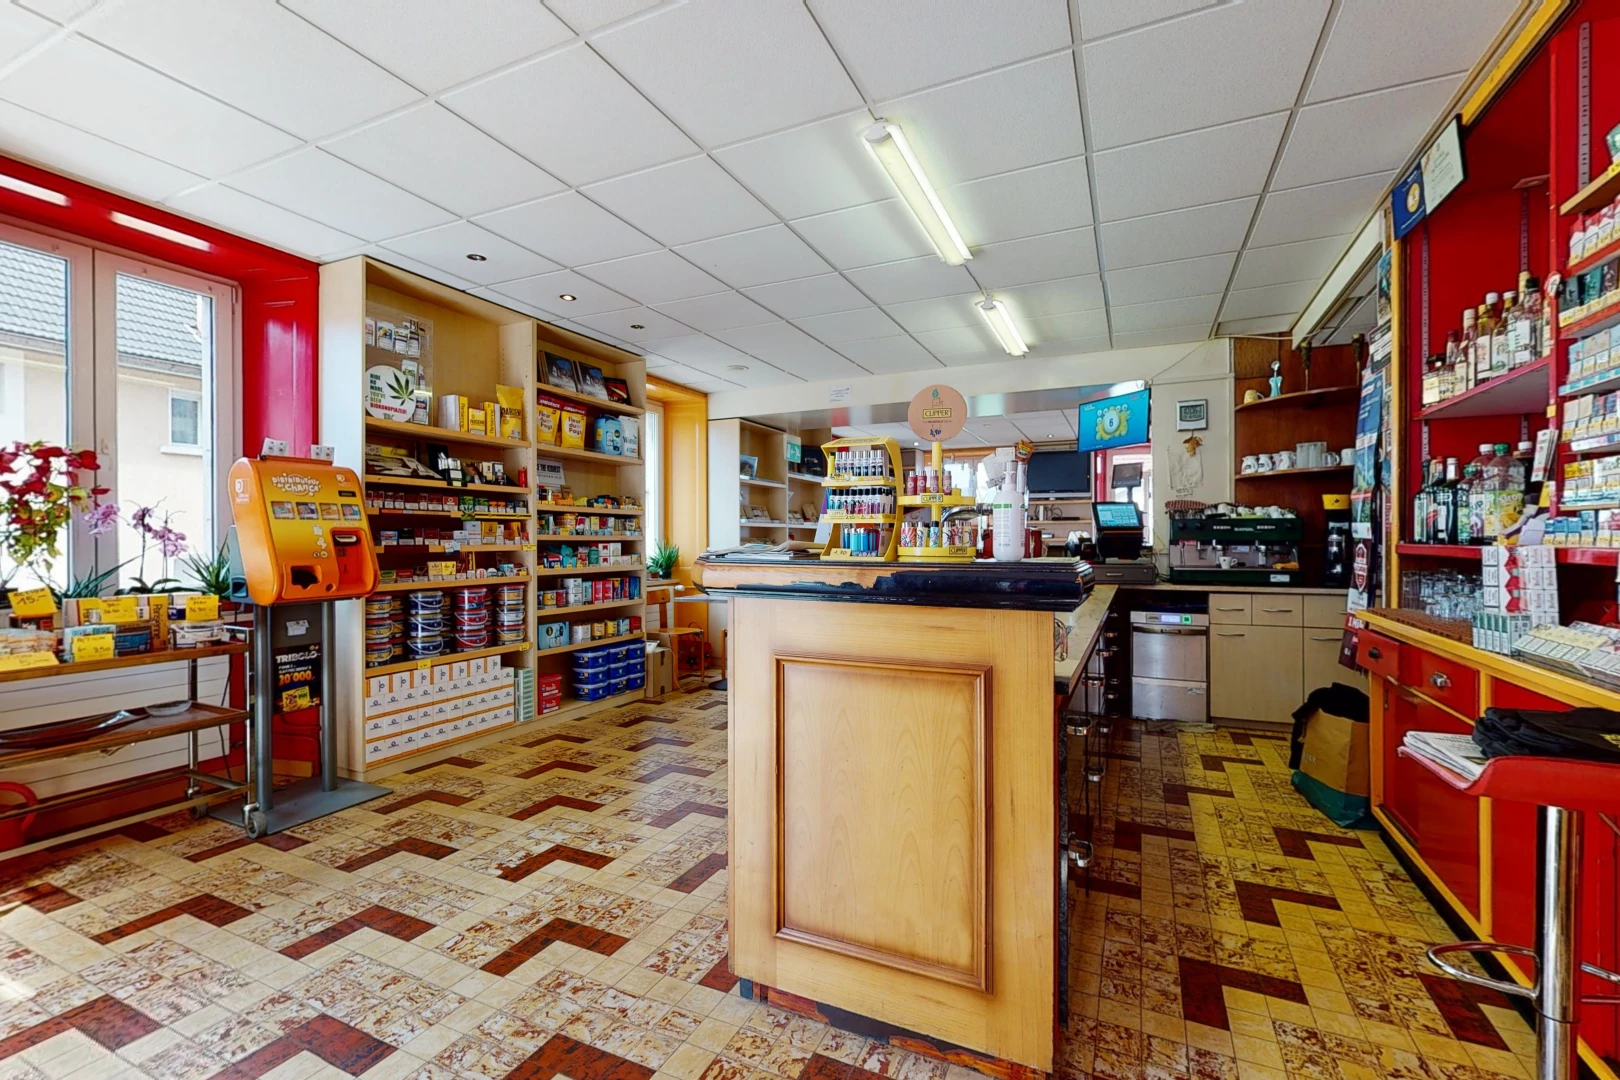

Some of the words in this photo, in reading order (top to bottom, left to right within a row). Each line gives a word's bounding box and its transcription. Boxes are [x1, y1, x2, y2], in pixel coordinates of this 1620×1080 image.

[568, 416, 581, 424] Fleur
[1108, 418, 1114, 427] 6
[275, 650, 318, 664] TRIBOLO
